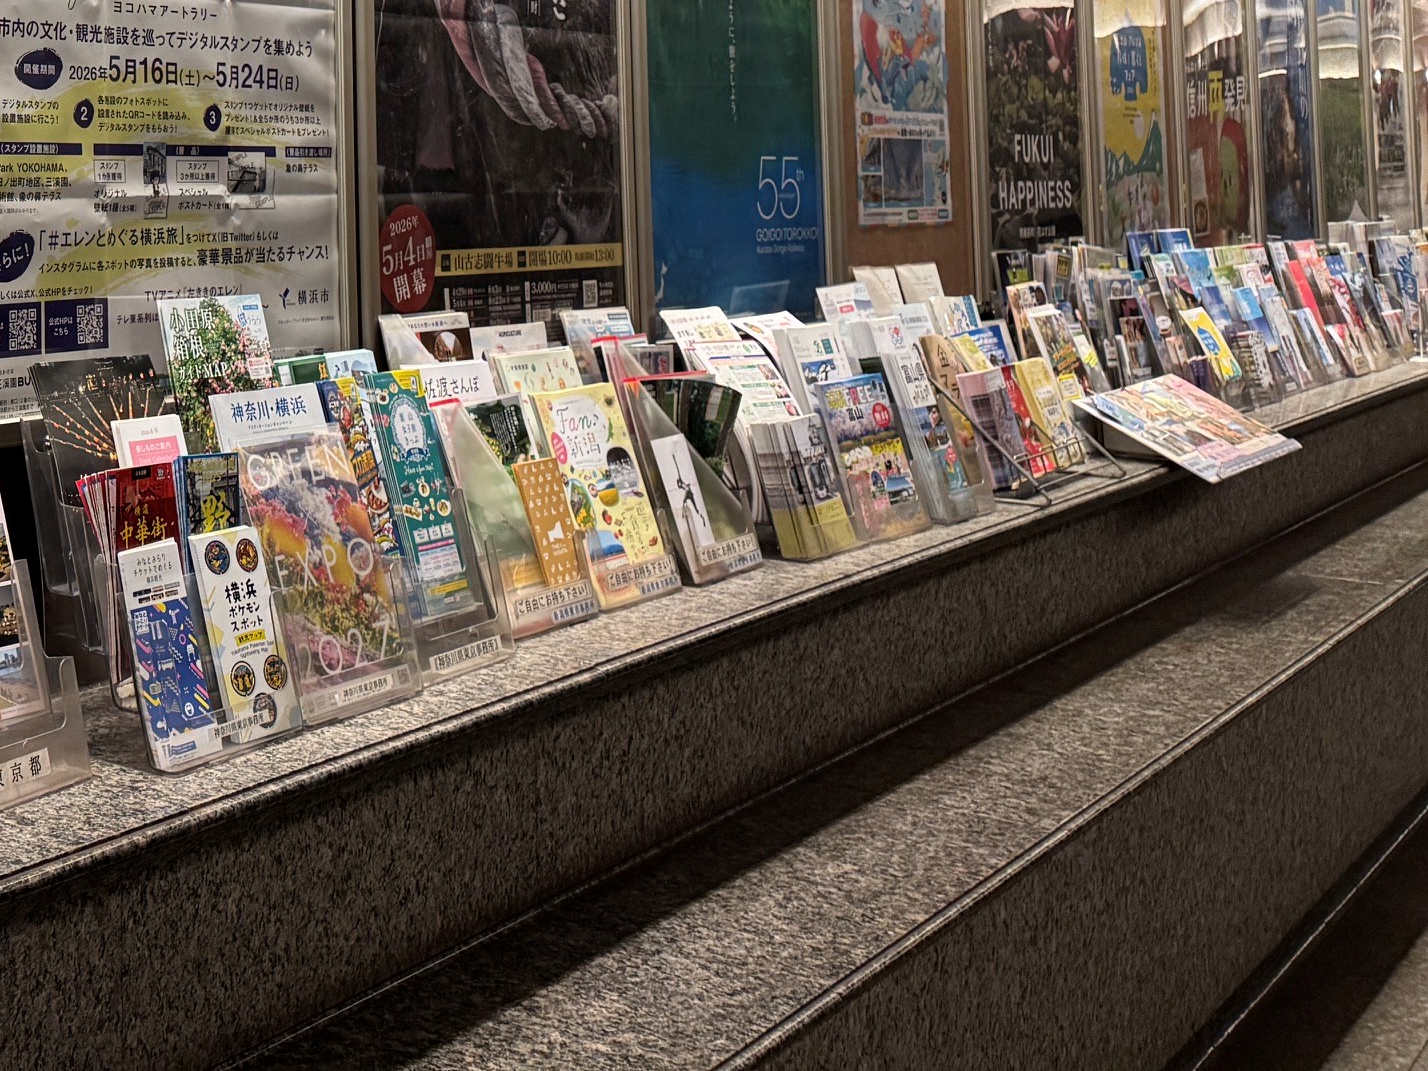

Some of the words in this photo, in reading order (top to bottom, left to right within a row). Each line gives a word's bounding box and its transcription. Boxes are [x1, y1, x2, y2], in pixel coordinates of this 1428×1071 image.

[113, 0, 218, 21] ヨコハマアートラリー
[23, 63, 56, 76] 開催期間
[1, 98, 59, 111] デジタルスタンプの
[1, 113, 59, 125] 設置施設に行こう!
[1013, 133, 1056, 165] FUKUI
[998, 179, 1073, 211] HAPPINESS
[389, 215, 420, 237] 2026年
[382, 235, 426, 276] 5月4日
[297, 288, 330, 305] 横浜市
[392, 267, 428, 304] 開幕
[53, 326, 69, 337] こちら
[170, 306, 217, 333] 小田原
[173, 335, 206, 361] 箱根
[230, 394, 308, 424] 神奈川・横浜
[567, 432, 601, 459] 新潟
[245, 439, 352, 492] GREEN
[119, 516, 168, 550] 中華街
[274, 537, 374, 593] EXPO
[224, 578, 258, 605] 横浜
[228, 601, 261, 618] ポケモン
[231, 617, 264, 633] スポット
[237, 631, 265, 644] 観光マップ
